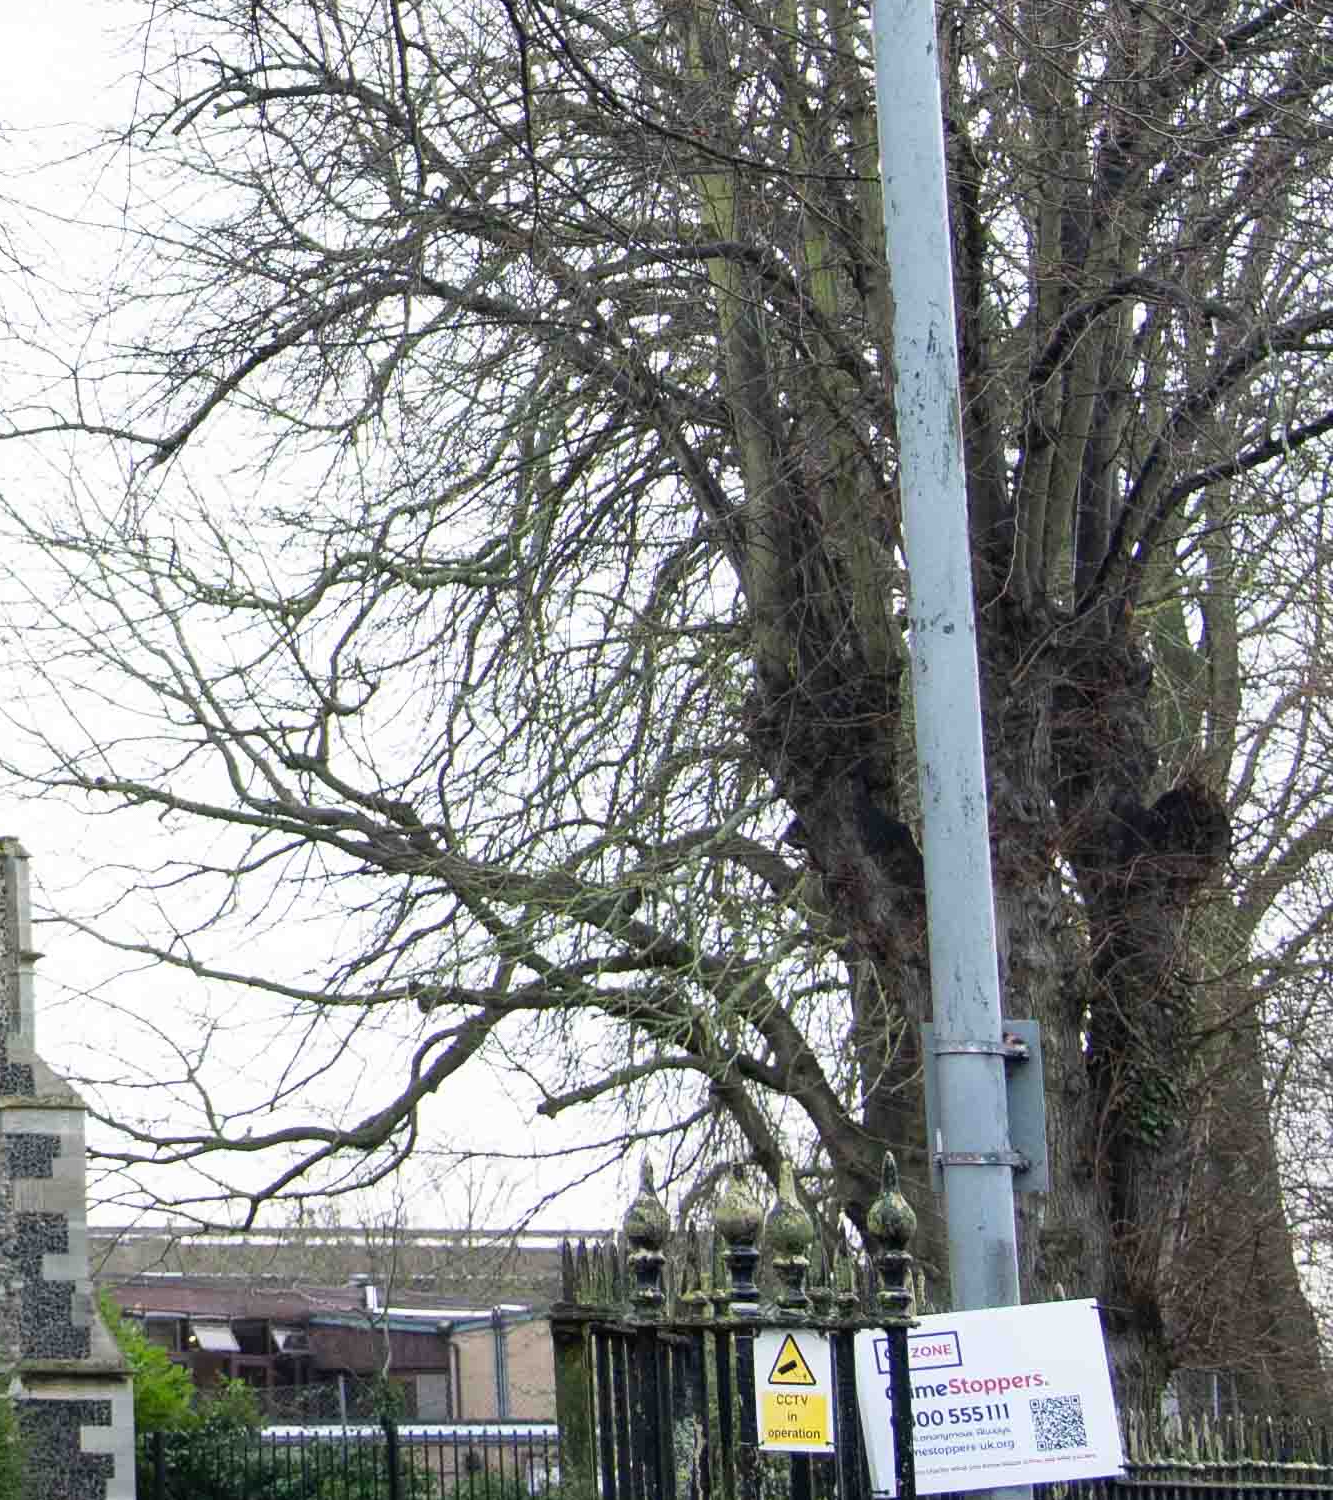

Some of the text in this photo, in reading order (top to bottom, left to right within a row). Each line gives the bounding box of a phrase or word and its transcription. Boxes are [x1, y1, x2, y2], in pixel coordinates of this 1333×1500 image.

[910, 1343, 952, 1359] ZONE
[885, 1372, 1050, 1400] CimeStoppers.
[776, 1394, 808, 1405] CCTV
[787, 1410, 797, 1421] in
[768, 1429, 821, 1440] operation
